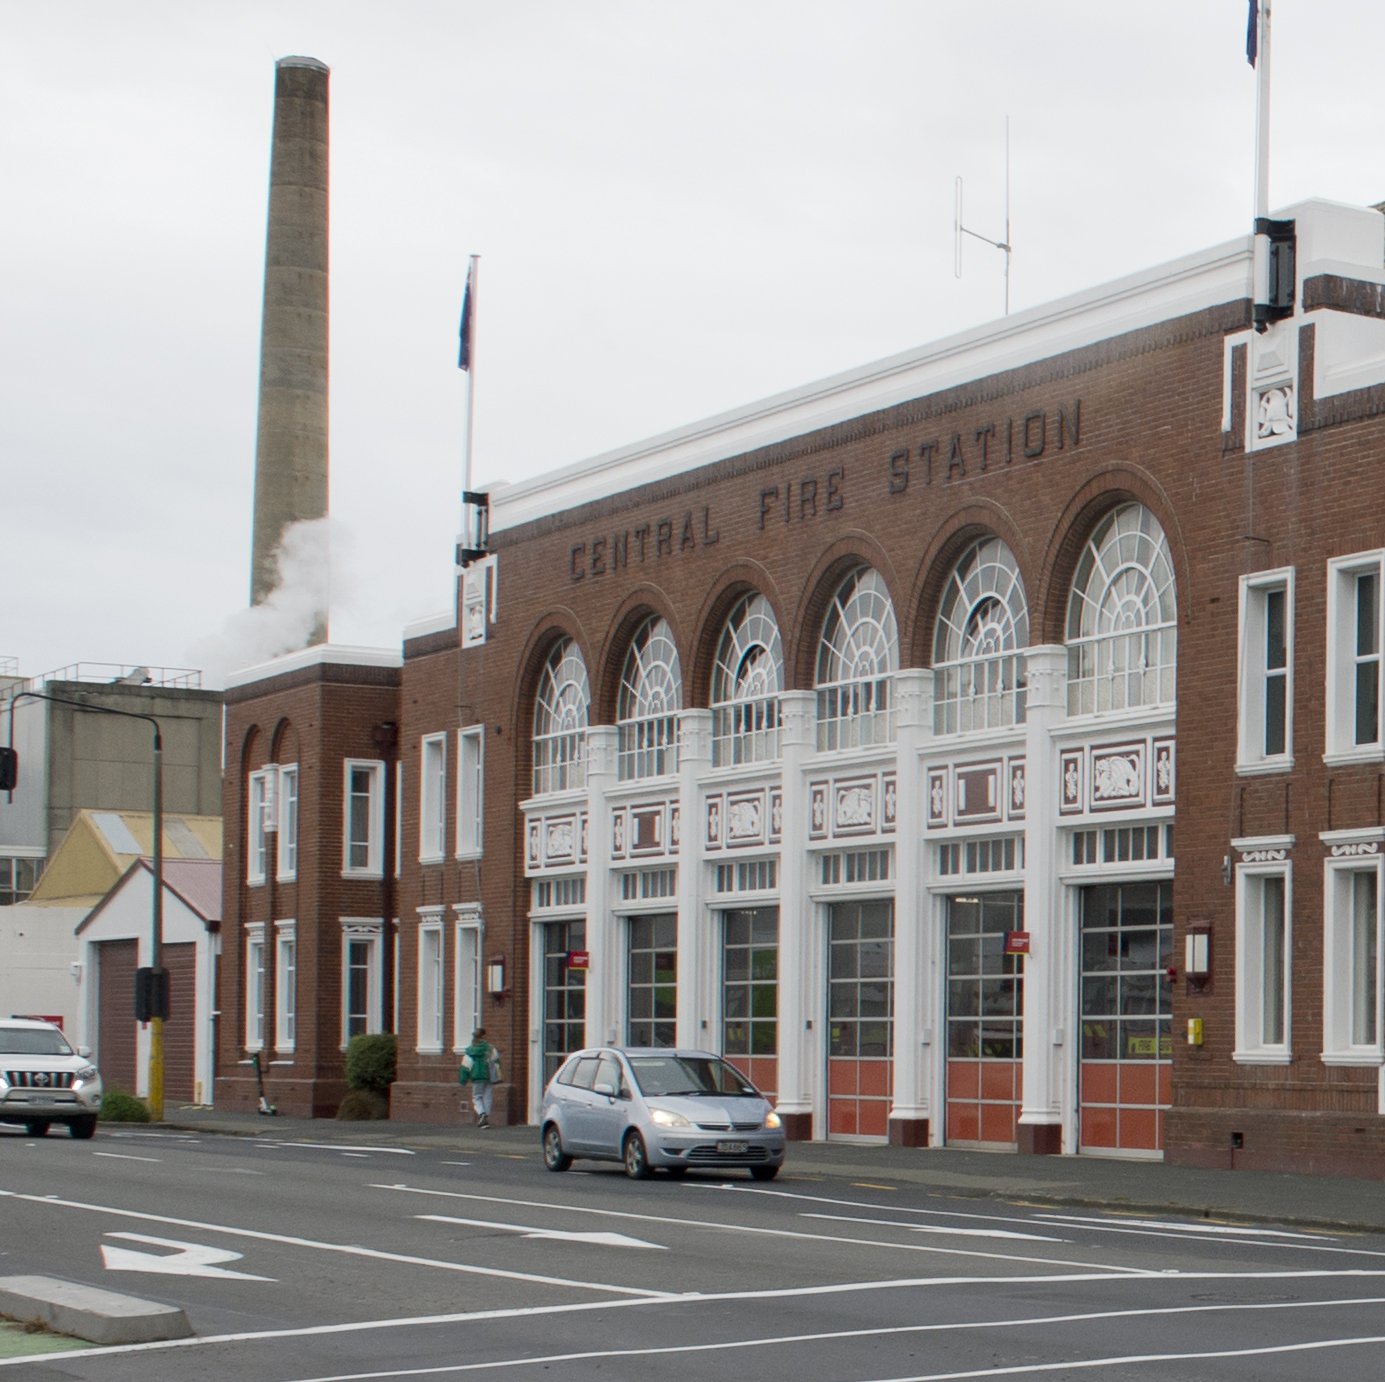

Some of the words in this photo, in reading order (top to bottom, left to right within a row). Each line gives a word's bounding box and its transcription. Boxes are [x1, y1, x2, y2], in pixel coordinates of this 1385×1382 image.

[568, 504, 719, 580] CENTRAL
[757, 465, 845, 531] FIRE
[888, 399, 1081, 495] STATION
